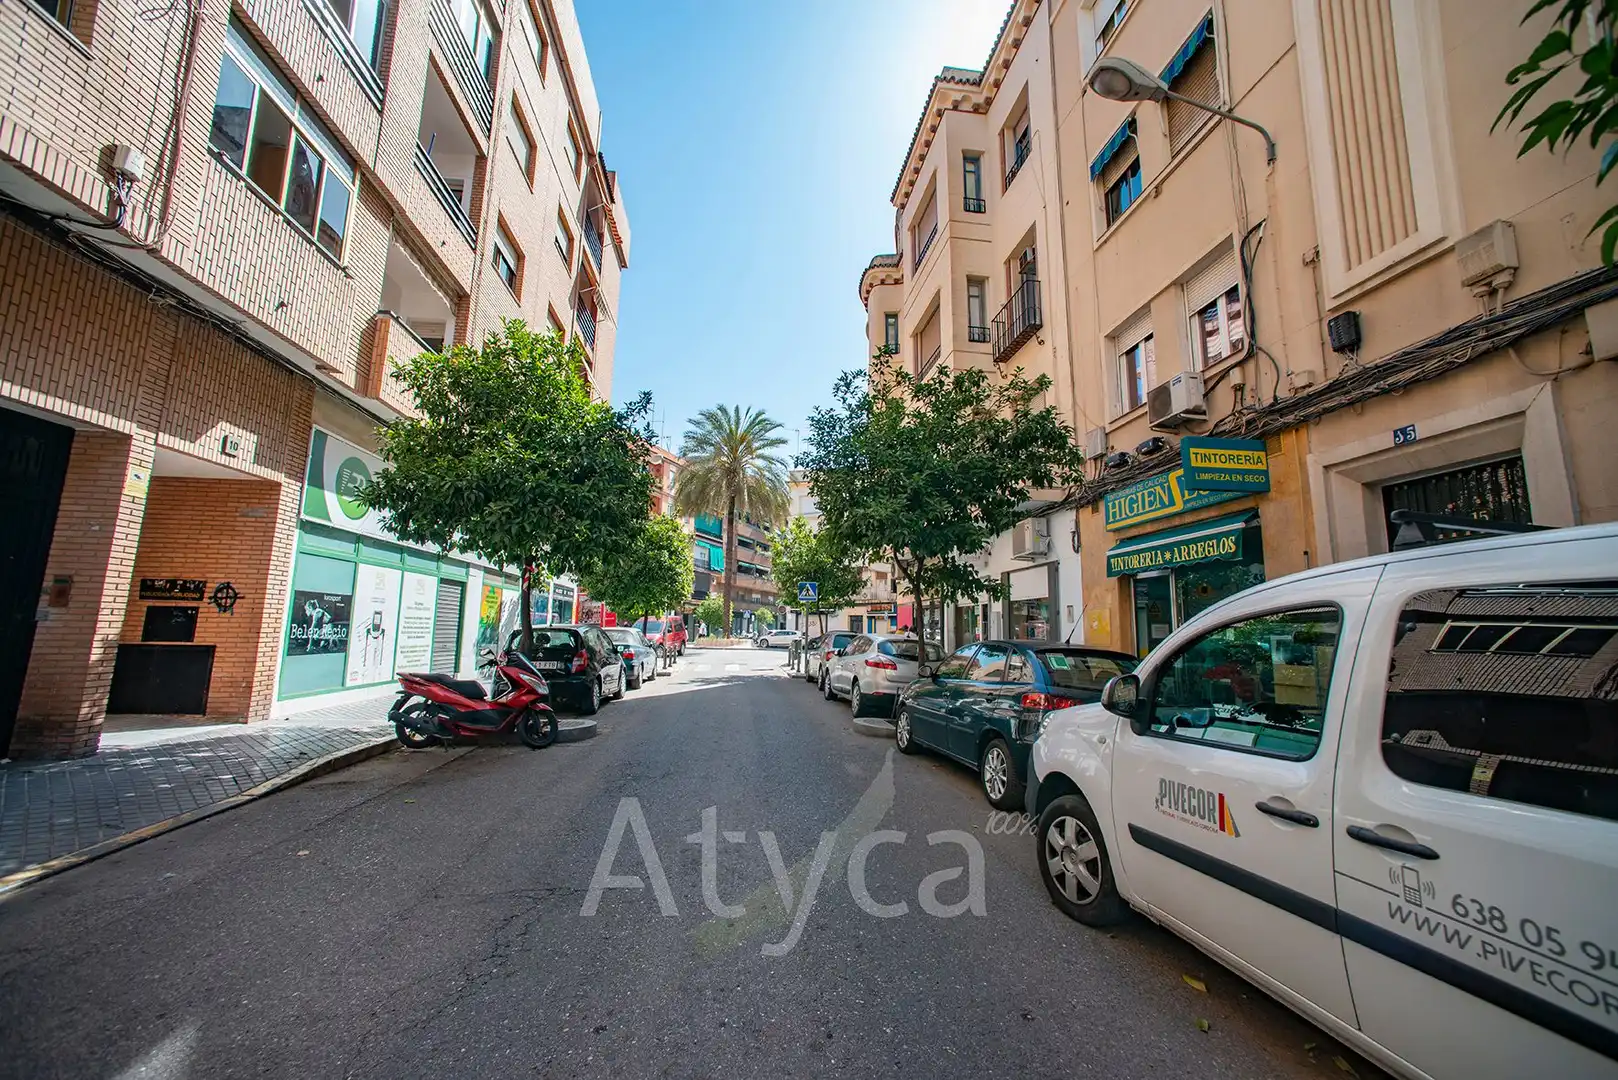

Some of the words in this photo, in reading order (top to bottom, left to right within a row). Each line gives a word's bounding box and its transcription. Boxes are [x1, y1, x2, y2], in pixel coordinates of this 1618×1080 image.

[229, 440, 239, 451] 10
[1192, 451, 1264, 466] TINTORERÍA
[1195, 472, 1231, 481] LIMPIEZA
[1232, 474, 1243, 482] EN
[1244, 474, 1266, 483] SECO
[1173, 536, 1237, 562] ARREGLOS
[1158, 777, 1217, 825] PIVECOR
[1451, 893, 1508, 934] 638
[1519, 917, 1567, 958] 05
